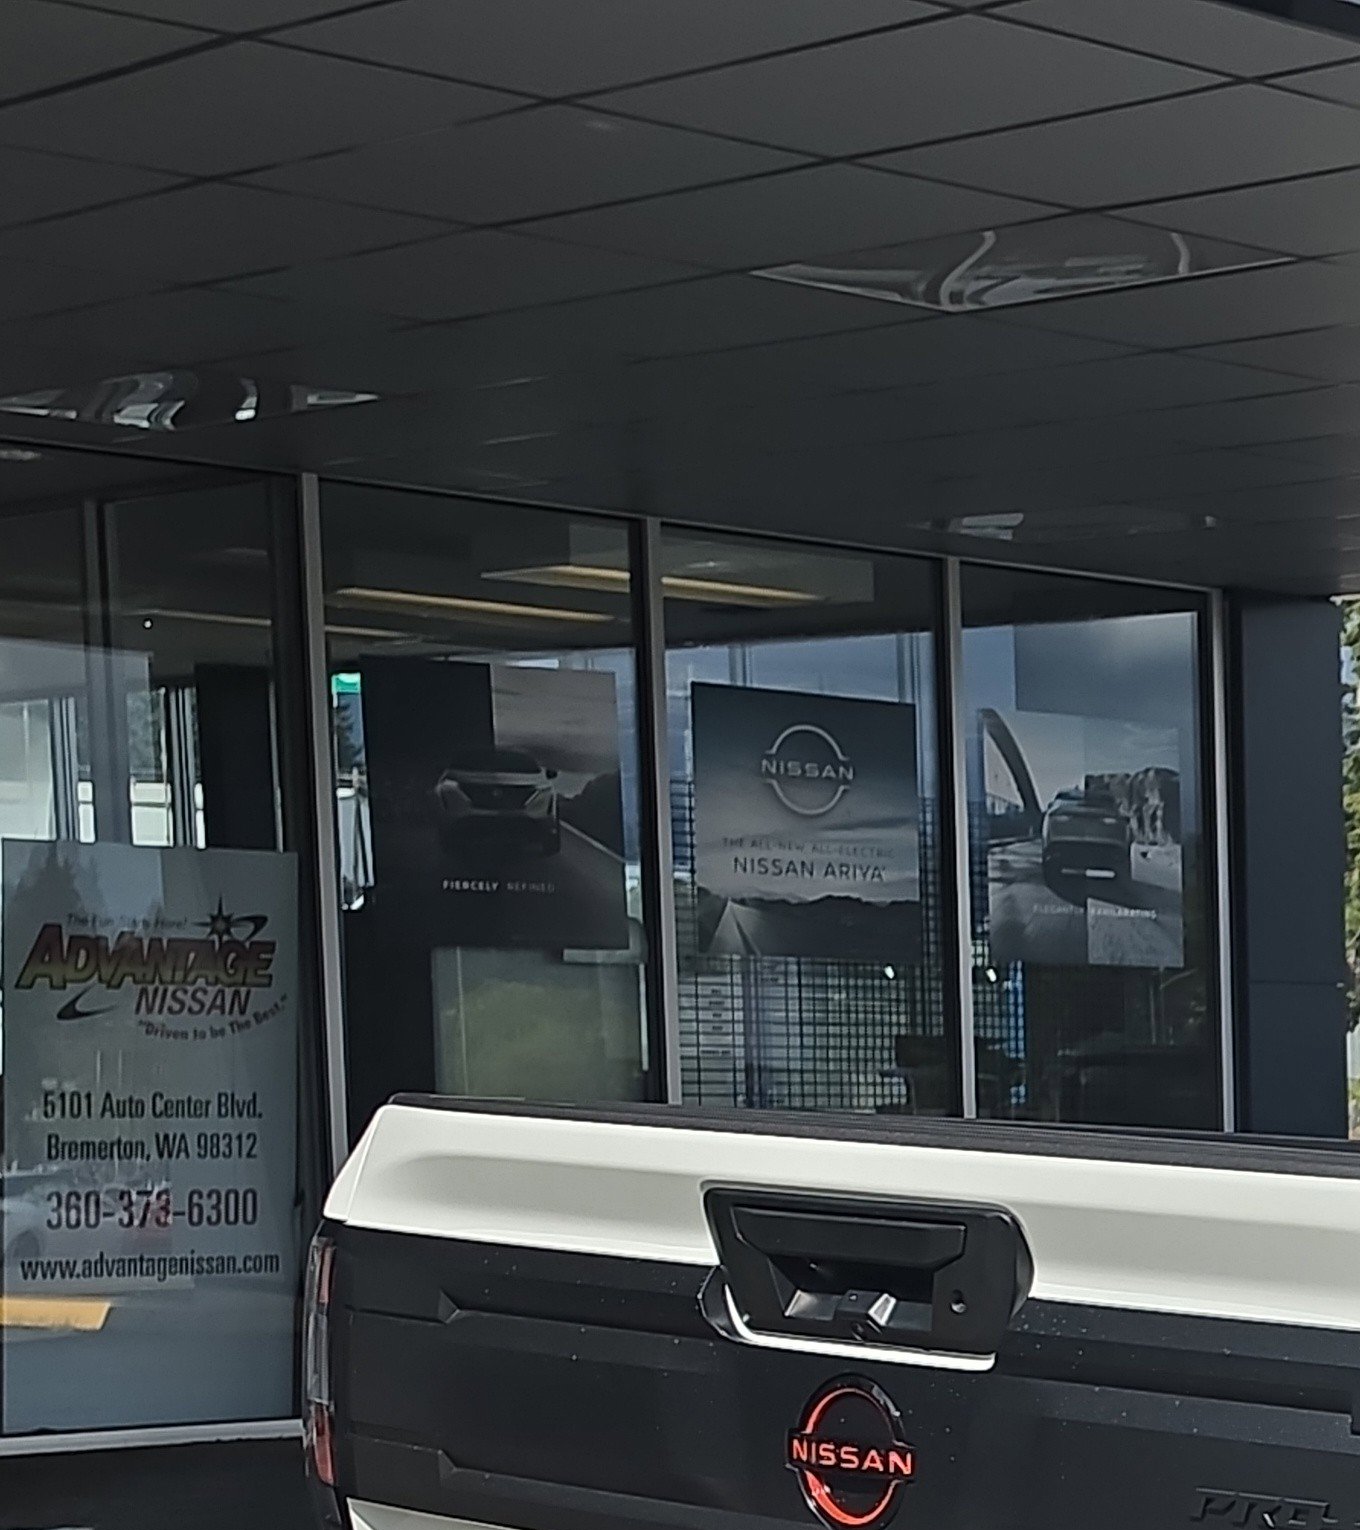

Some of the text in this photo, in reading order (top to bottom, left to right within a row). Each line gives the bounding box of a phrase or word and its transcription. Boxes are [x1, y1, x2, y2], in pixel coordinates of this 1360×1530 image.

[761, 758, 854, 780] NISSAN
[733, 857, 815, 879] NISSAN
[15, 923, 277, 990] ADVANTAGE
[135, 985, 251, 1016] NISSAN
[43, 1091, 264, 1120] 5101 Auto Center Blvd.
[47, 1132, 259, 1162] Bremerton, WA 98312
[46, 1187, 259, 1231] 360-373-6300
[20, 1250, 280, 1282] www.advantagenissan.com
[792, 1438, 912, 1475] NISSAN
